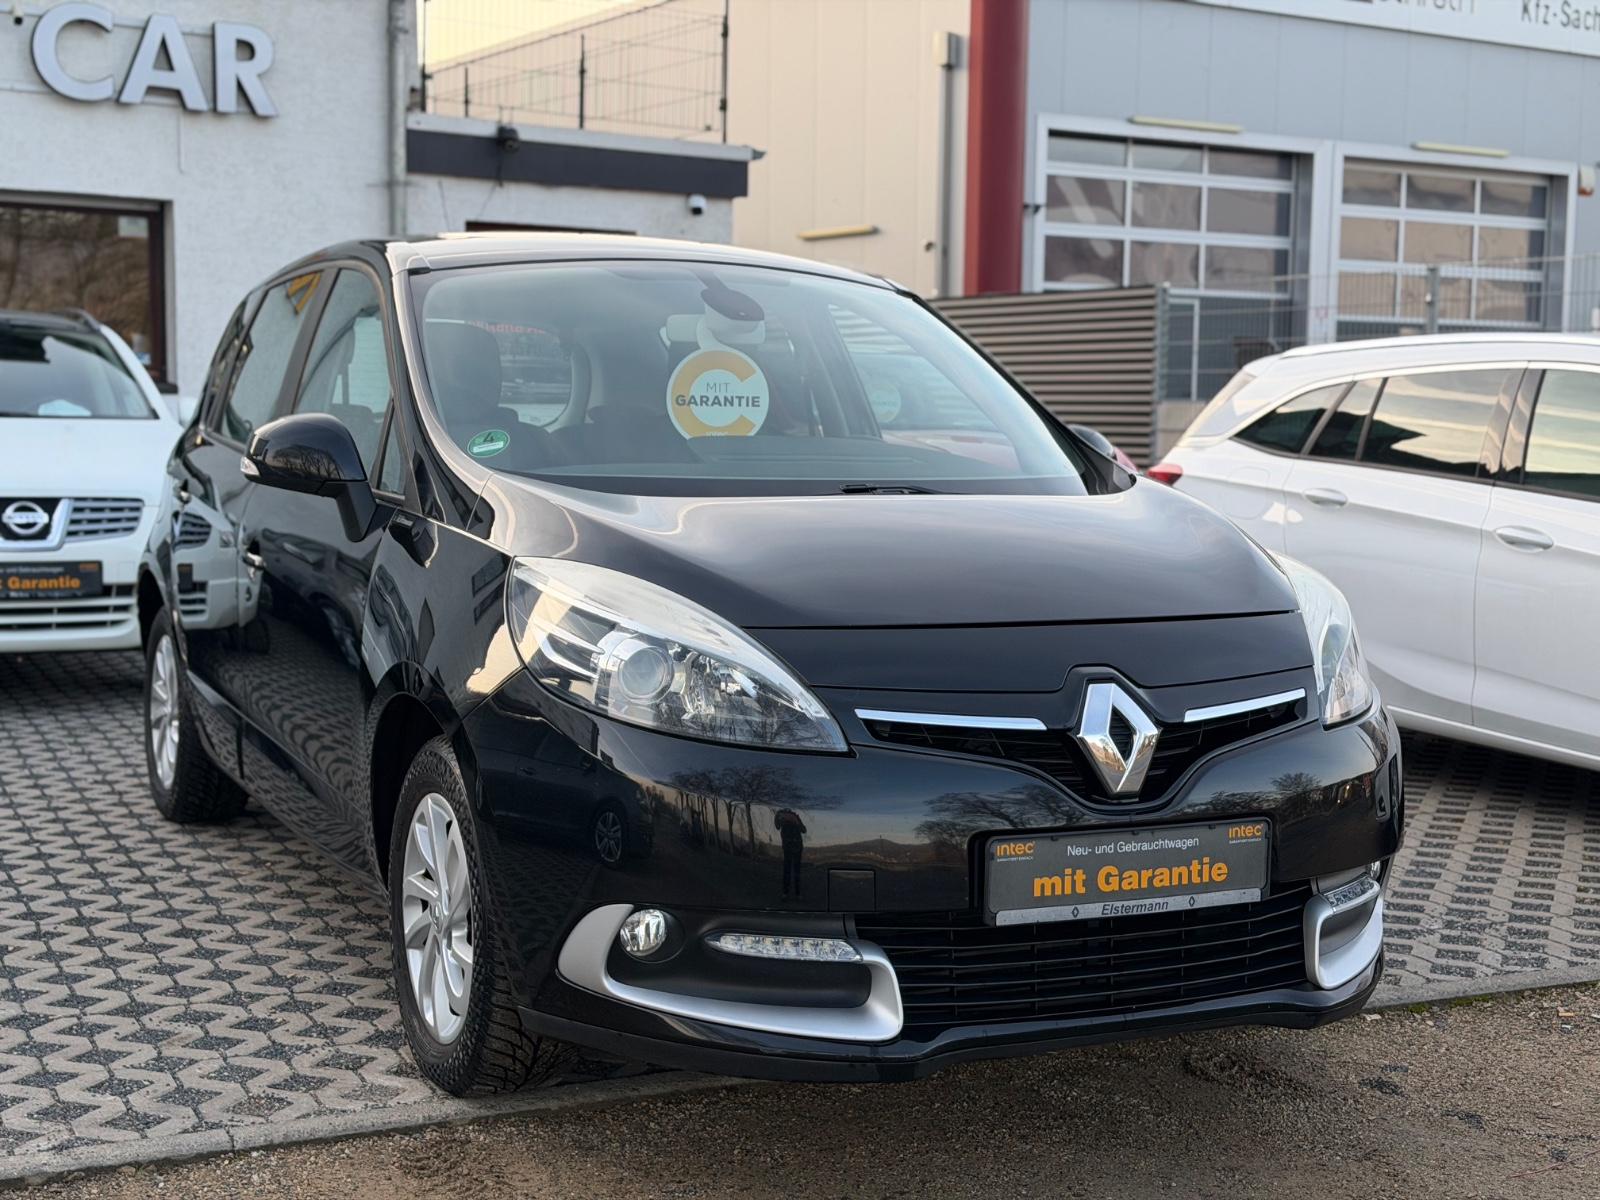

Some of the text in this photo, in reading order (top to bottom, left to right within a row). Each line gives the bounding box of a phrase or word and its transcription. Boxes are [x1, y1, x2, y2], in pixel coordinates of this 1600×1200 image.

[31, 2, 278, 117] CAR
[706, 382, 730, 393] MIT
[675, 394, 760, 408] GARANTIE
[8, 576, 81, 590] Garantie
[1229, 824, 1263, 838] intec
[997, 841, 1035, 856] intec
[1067, 836, 1199, 856] Neu- und Gebrauchtwagen
[1033, 857, 1228, 897] mit Garantie
[1101, 900, 1168, 915] Elstermann
